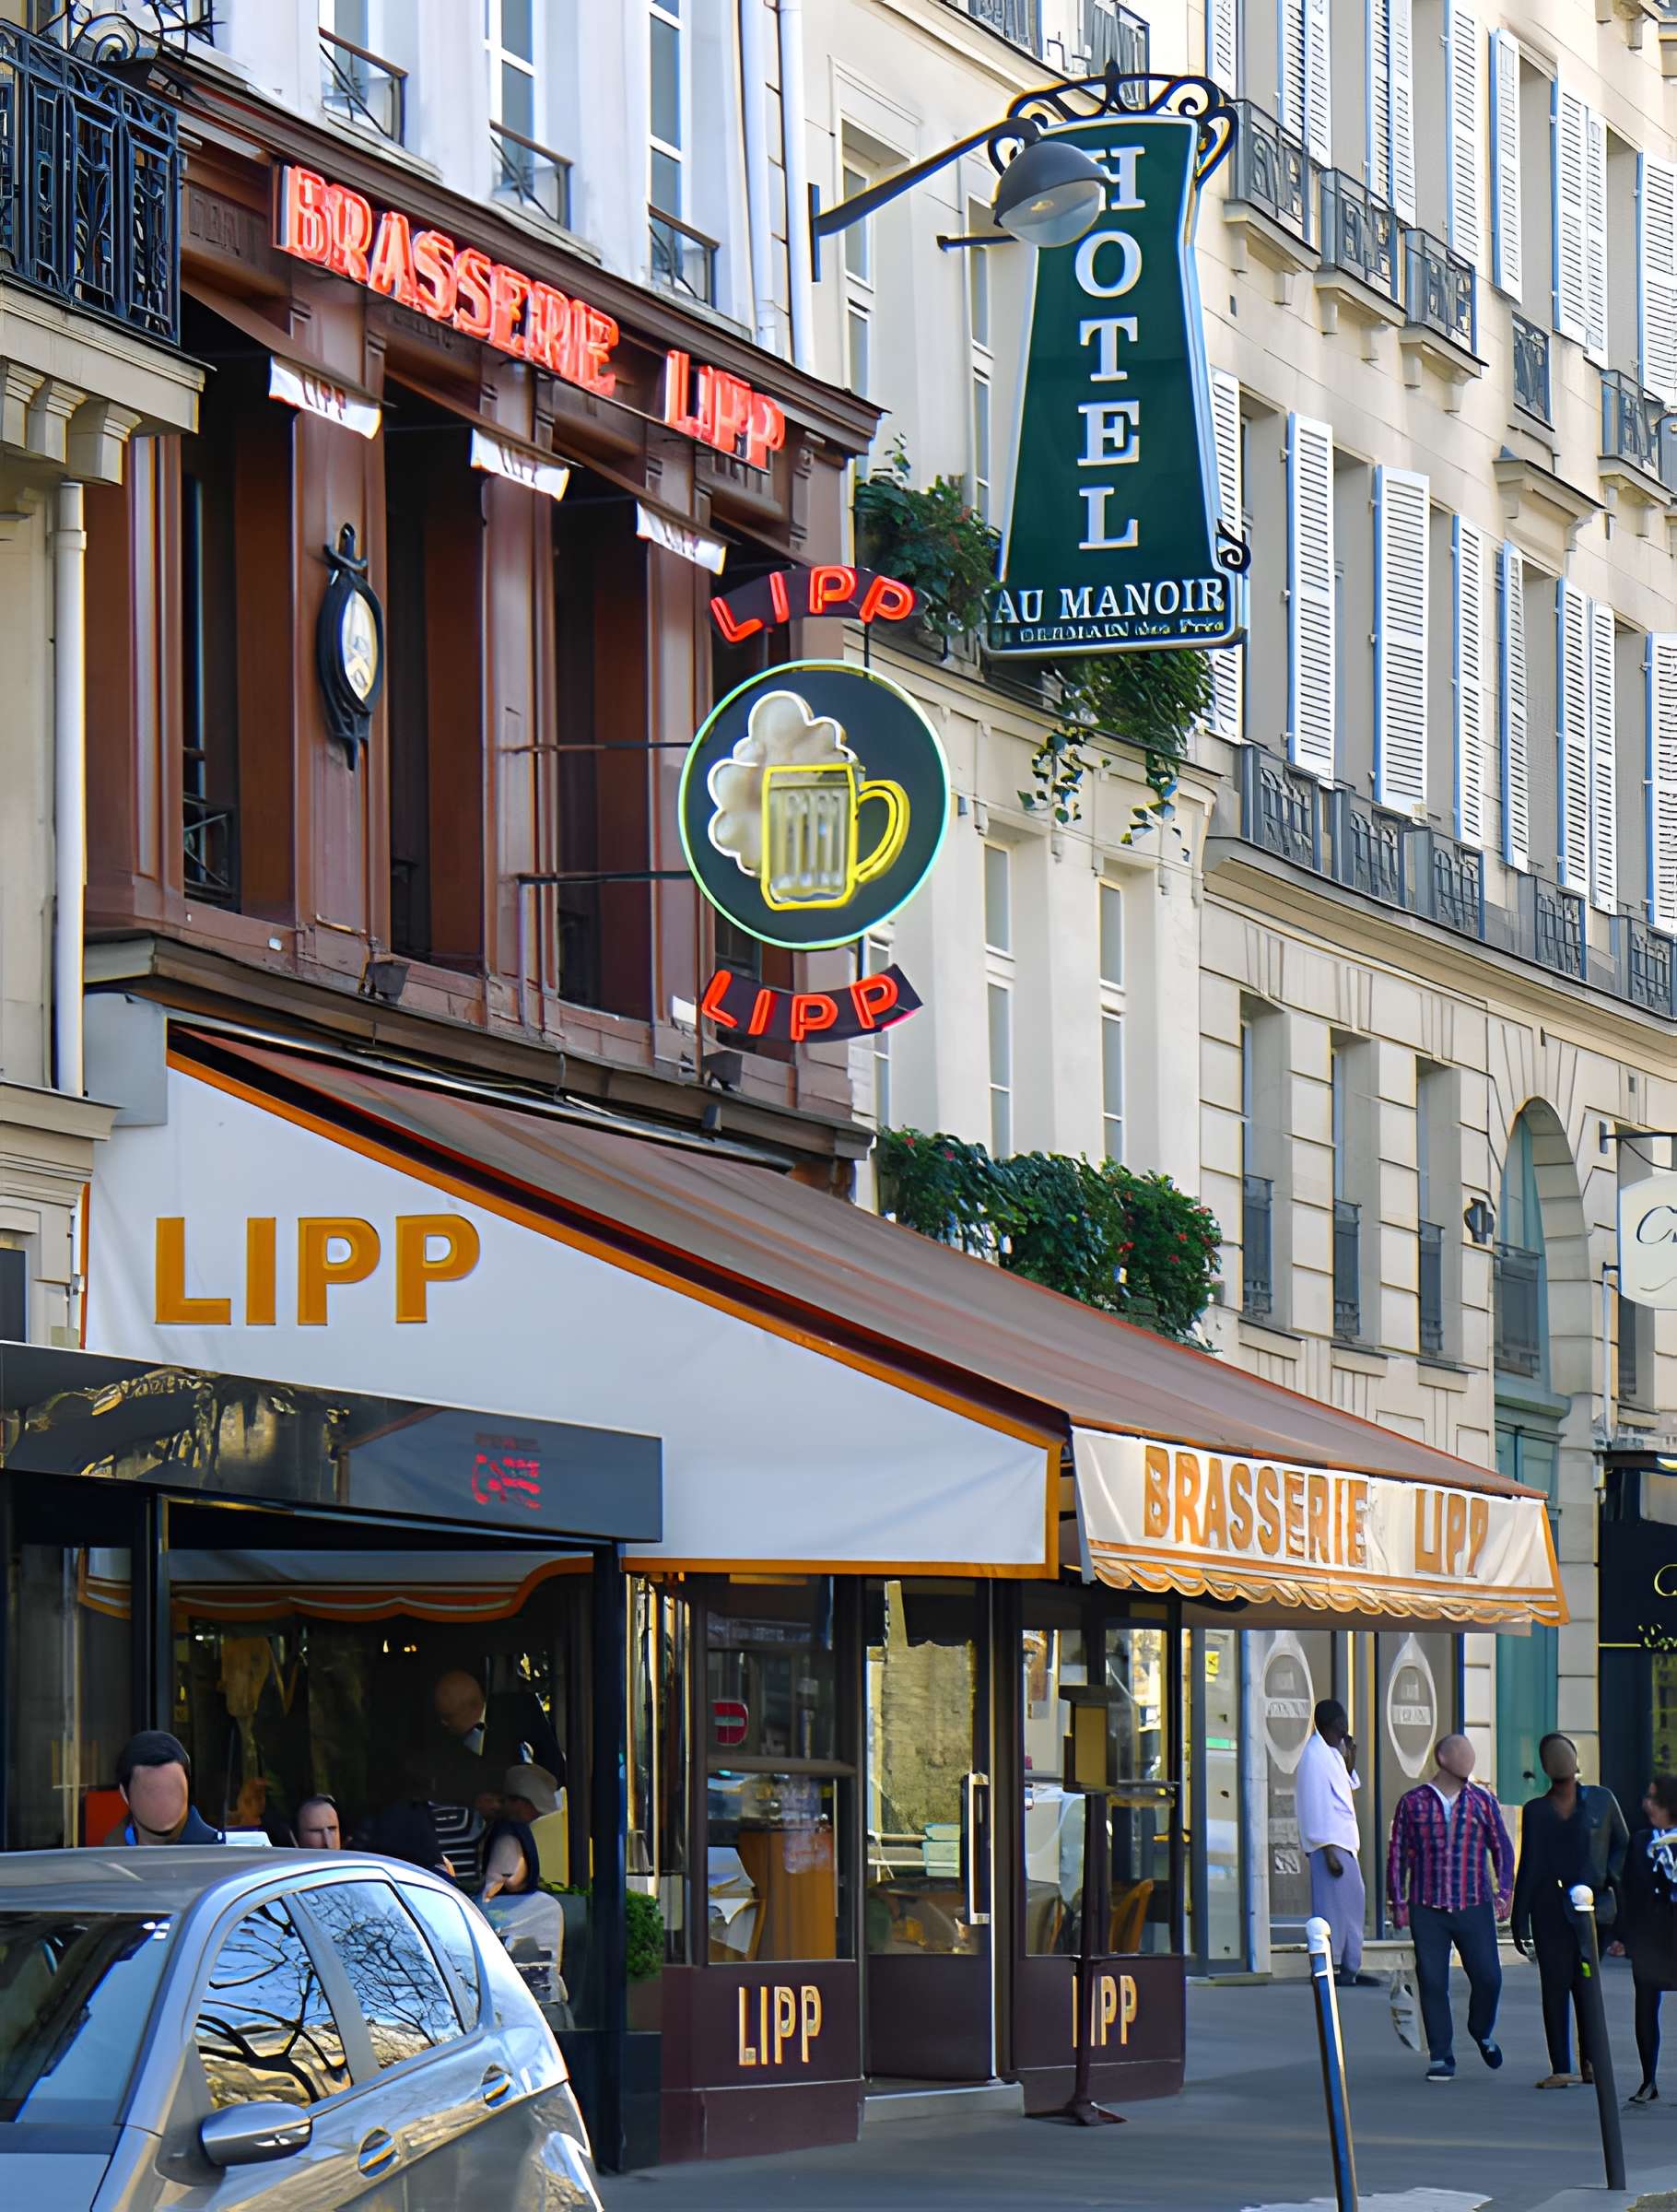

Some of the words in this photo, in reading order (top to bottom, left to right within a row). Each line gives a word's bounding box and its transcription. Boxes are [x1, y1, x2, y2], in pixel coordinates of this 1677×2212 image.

[283, 165, 619, 397] BRASSERIE
[664, 349, 786, 470] LIPP
[710, 564, 917, 643] LIPP
[993, 588, 1043, 624] AU
[1060, 578, 1225, 620] MANOIR
[701, 969, 898, 1041] LIPP
[155, 1213, 481, 1326] LIPP
[1143, 1444, 1368, 1569] BRASSERIE
[1414, 1488, 1489, 1578] LIPP
[738, 1984, 823, 2065] LIPP
